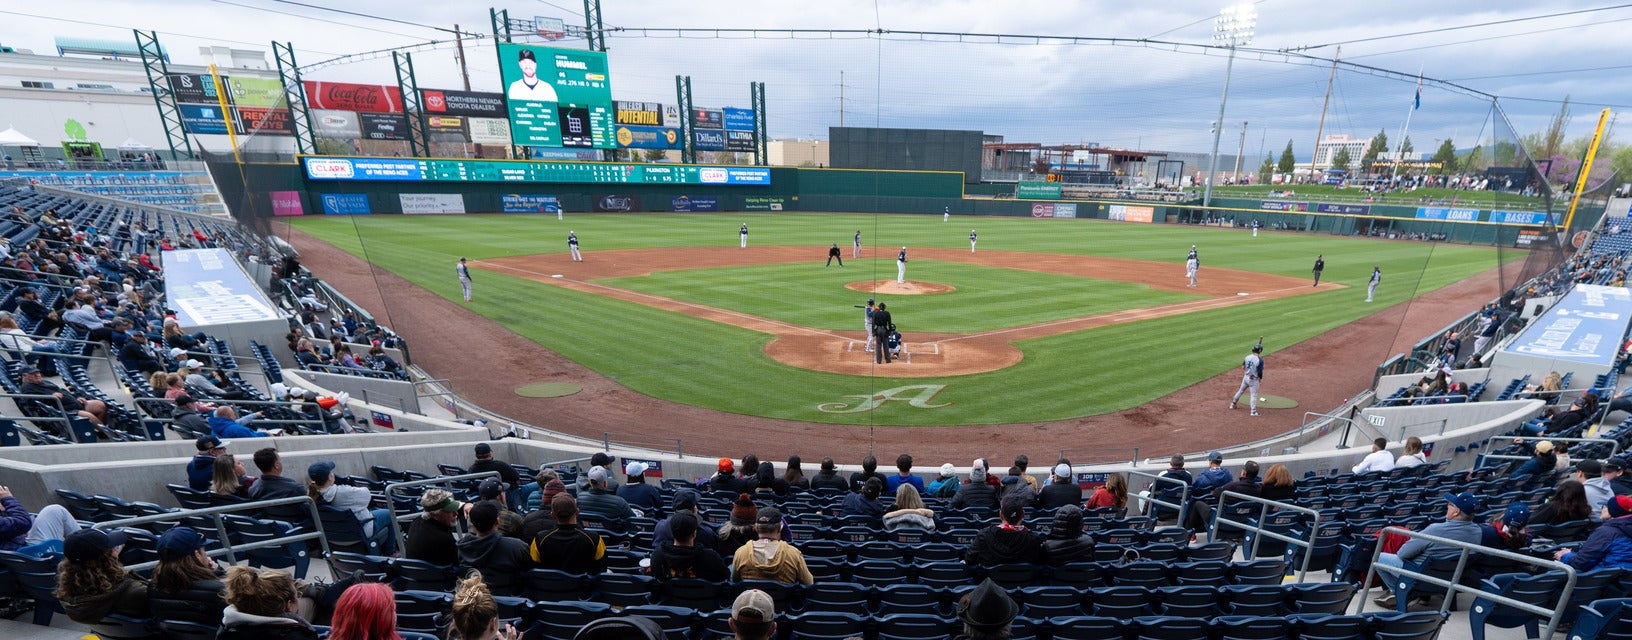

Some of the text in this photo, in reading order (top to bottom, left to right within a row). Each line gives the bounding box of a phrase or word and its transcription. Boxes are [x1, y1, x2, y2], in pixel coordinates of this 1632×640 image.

[618, 101, 642, 110] UNLEASH
[244, 112, 288, 121] RENTAL
[618, 110, 658, 124] POTENTIAL
[252, 121, 283, 129] GUYS
[696, 132, 722, 142] Dillard's
[735, 132, 753, 140] LITHIA
[1448, 210, 1473, 219] LOANS
[1504, 213, 1533, 224] BASES!
[1370, 415, 1384, 425] EXIT
